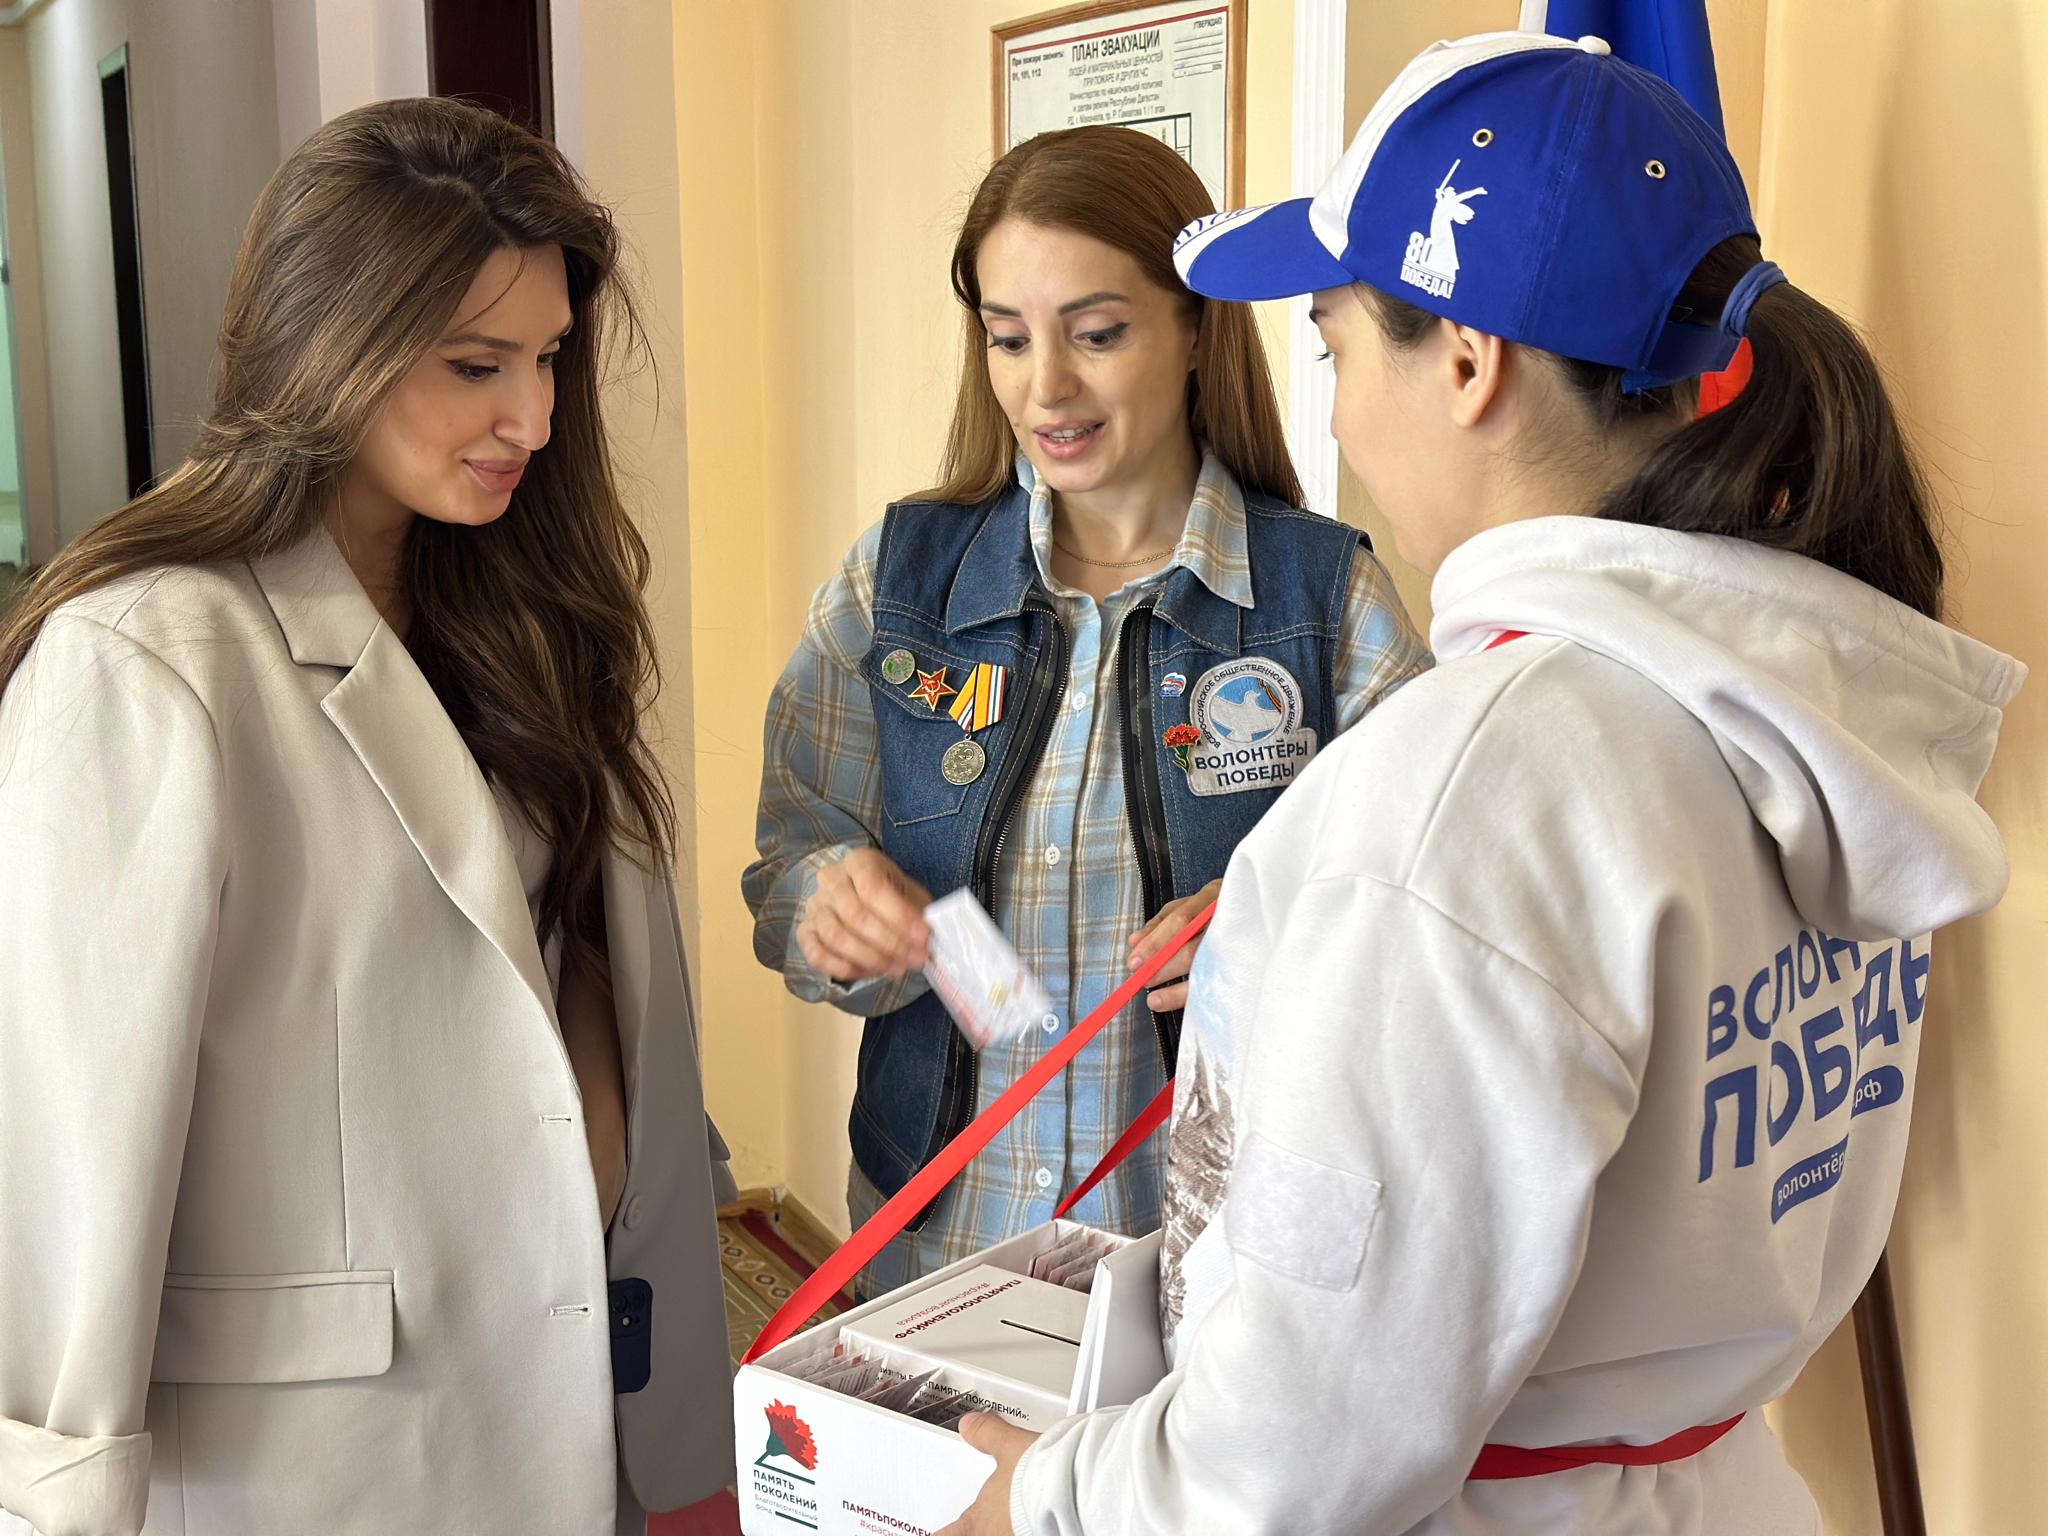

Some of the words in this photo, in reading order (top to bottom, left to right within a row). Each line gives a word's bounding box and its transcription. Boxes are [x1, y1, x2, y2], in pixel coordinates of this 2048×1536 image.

[1072, 41, 1099, 62] ПЛАН
[1101, 29, 1160, 56] ЭВАКУАЦИИ
[1405, 231, 1432, 266] 80
[1400, 264, 1455, 300] ПОБЕДА!
[1197, 681, 1221, 749] ВСЕРОССИЙСКОЕ
[1215, 664, 1285, 685] ОБЩЕСТВЕННОЕ
[1281, 683, 1296, 736] ДВИЖЕНИЕ
[1195, 738, 1308, 770] ВОЛОНТЁРЫ
[1217, 762, 1295, 787] ПОБЕДЫ
[895, 1279, 1022, 1339] ПАМЯТЬПОКОЛЕНИЙ.РФ
[754, 1469, 795, 1490] ПАМЯТЬ
[755, 1482, 817, 1511] ПОКОЛЕНИЙ
